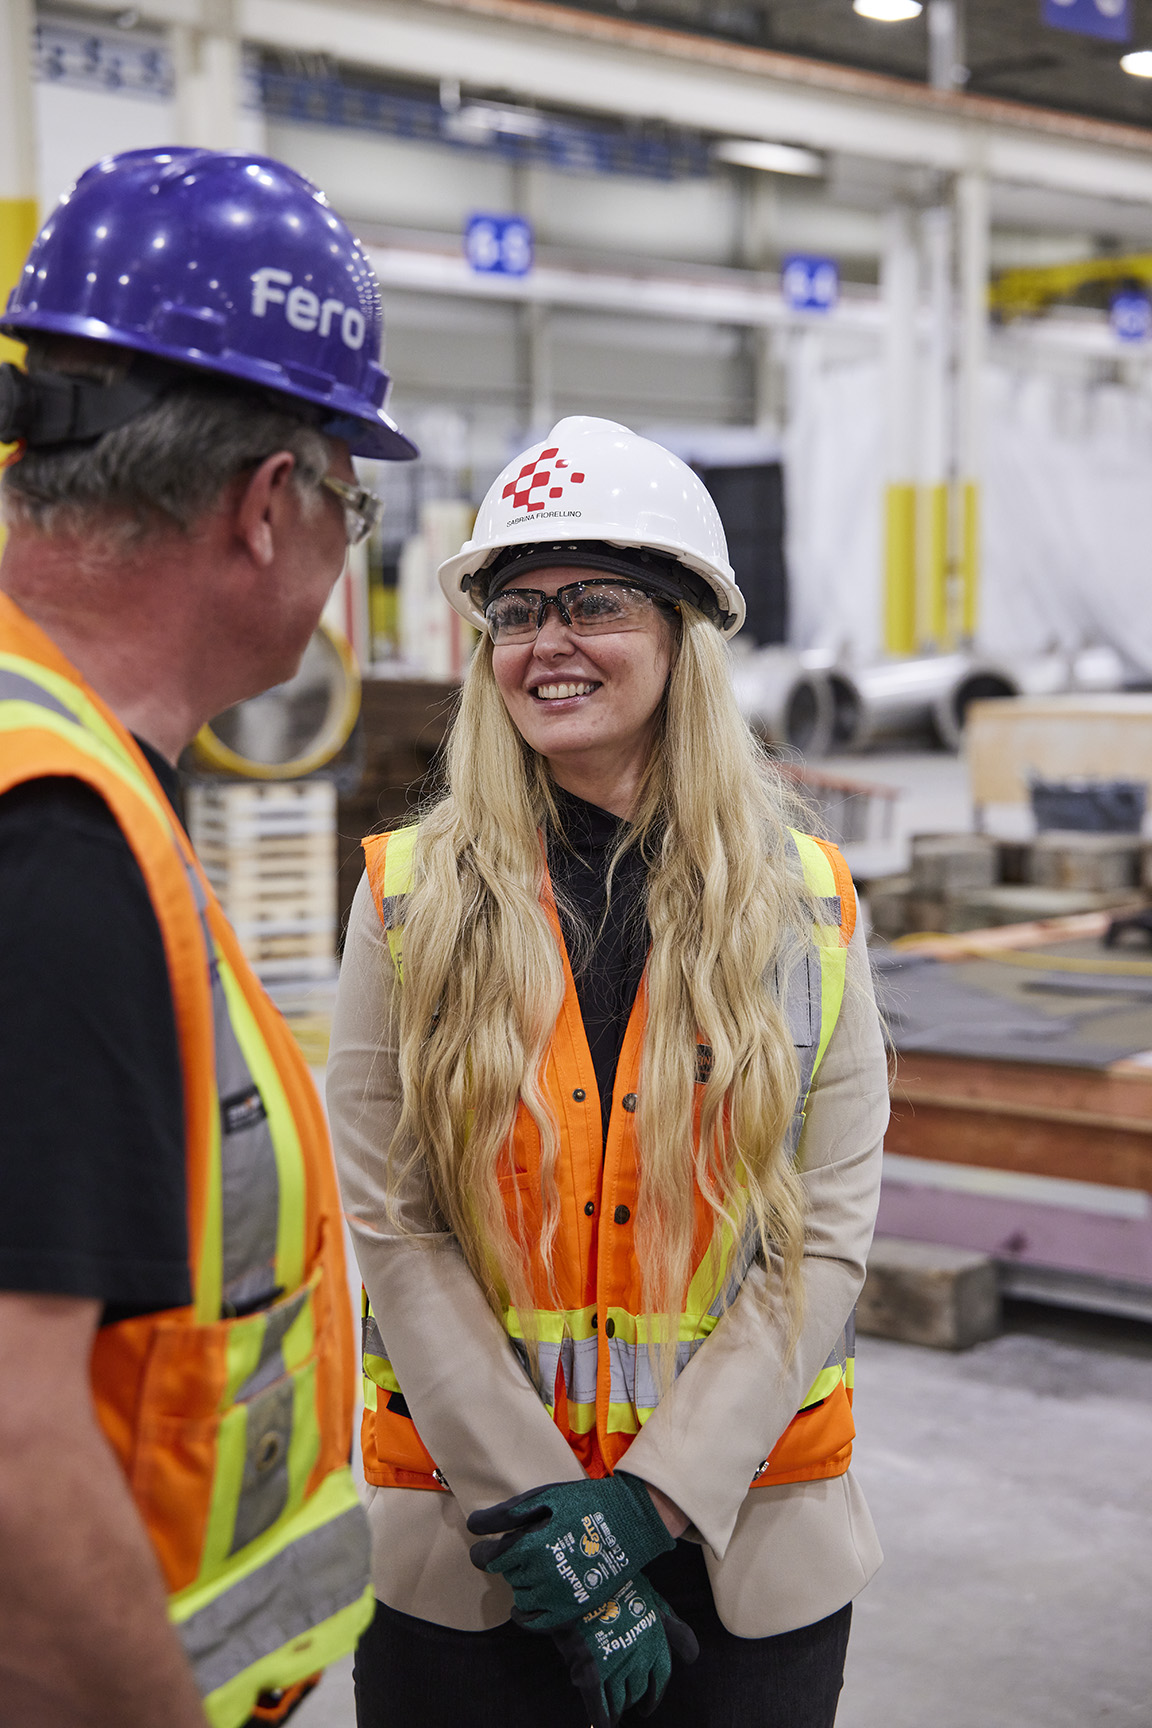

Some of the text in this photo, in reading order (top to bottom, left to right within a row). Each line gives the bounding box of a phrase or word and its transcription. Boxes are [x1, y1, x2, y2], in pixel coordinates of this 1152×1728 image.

[251, 267, 365, 351] Fero
[506, 510, 582, 528] SABRINA FIORELLINO
